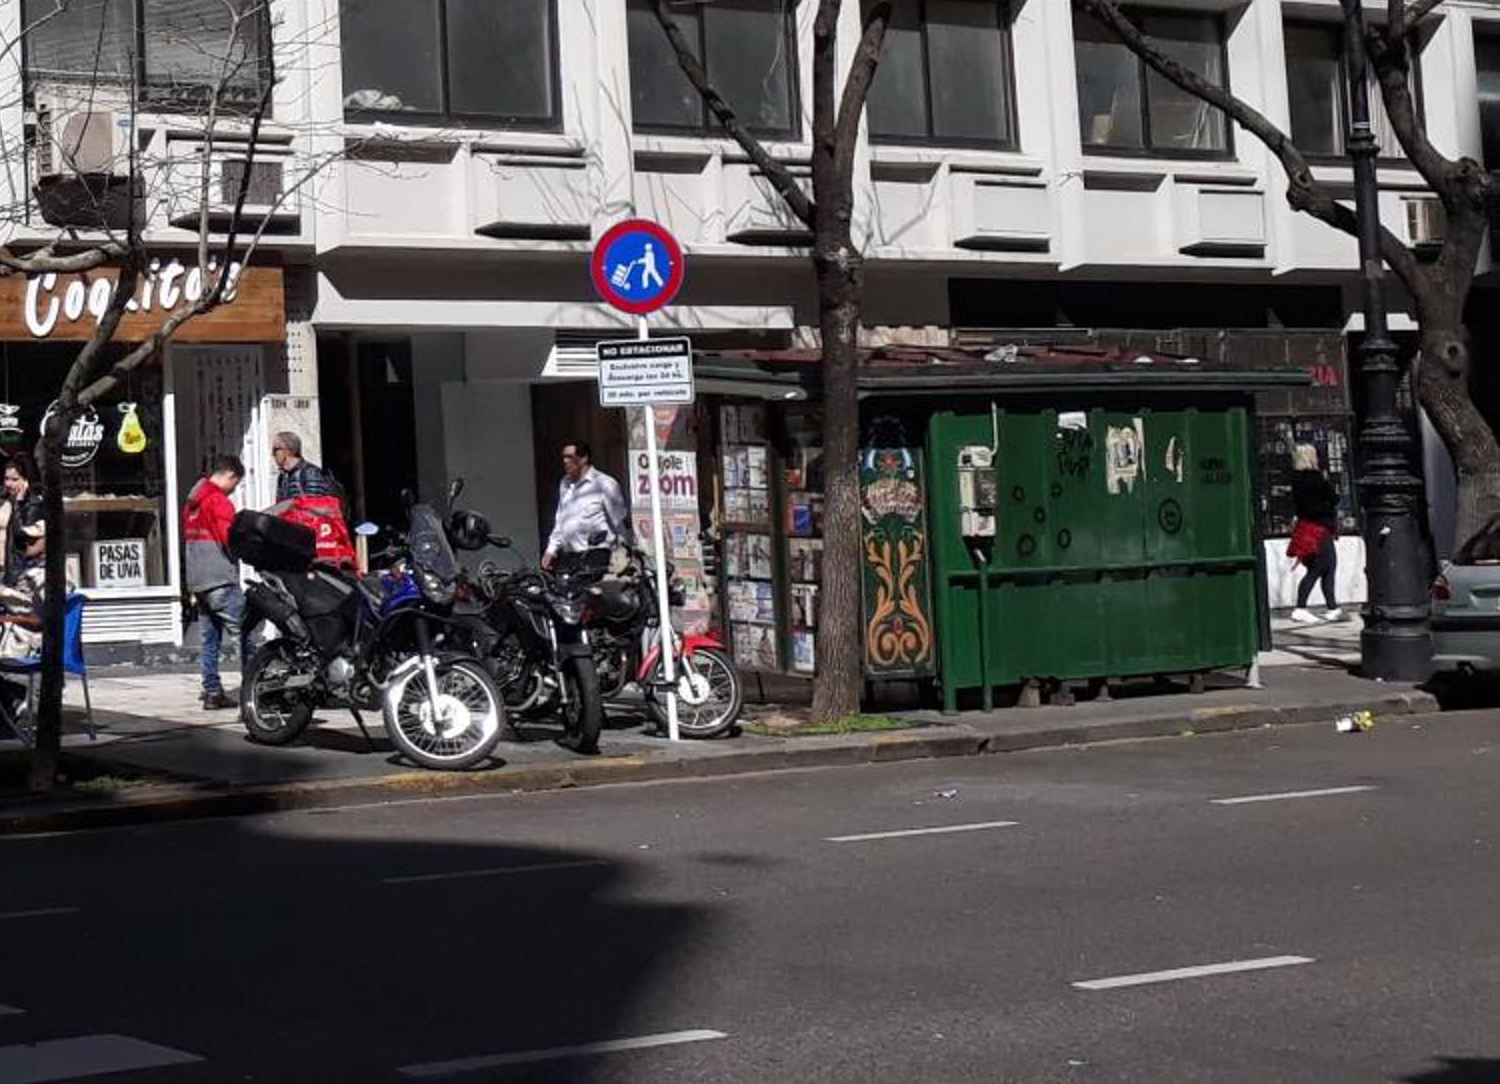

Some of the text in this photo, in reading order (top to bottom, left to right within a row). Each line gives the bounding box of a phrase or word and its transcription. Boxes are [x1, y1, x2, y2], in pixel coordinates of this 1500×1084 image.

[603, 343, 684, 356] NO ESTACIONAR
[638, 474, 695, 496] zom
[100, 544, 139, 562] PASAS
[100, 562, 142, 580] DE UVA
